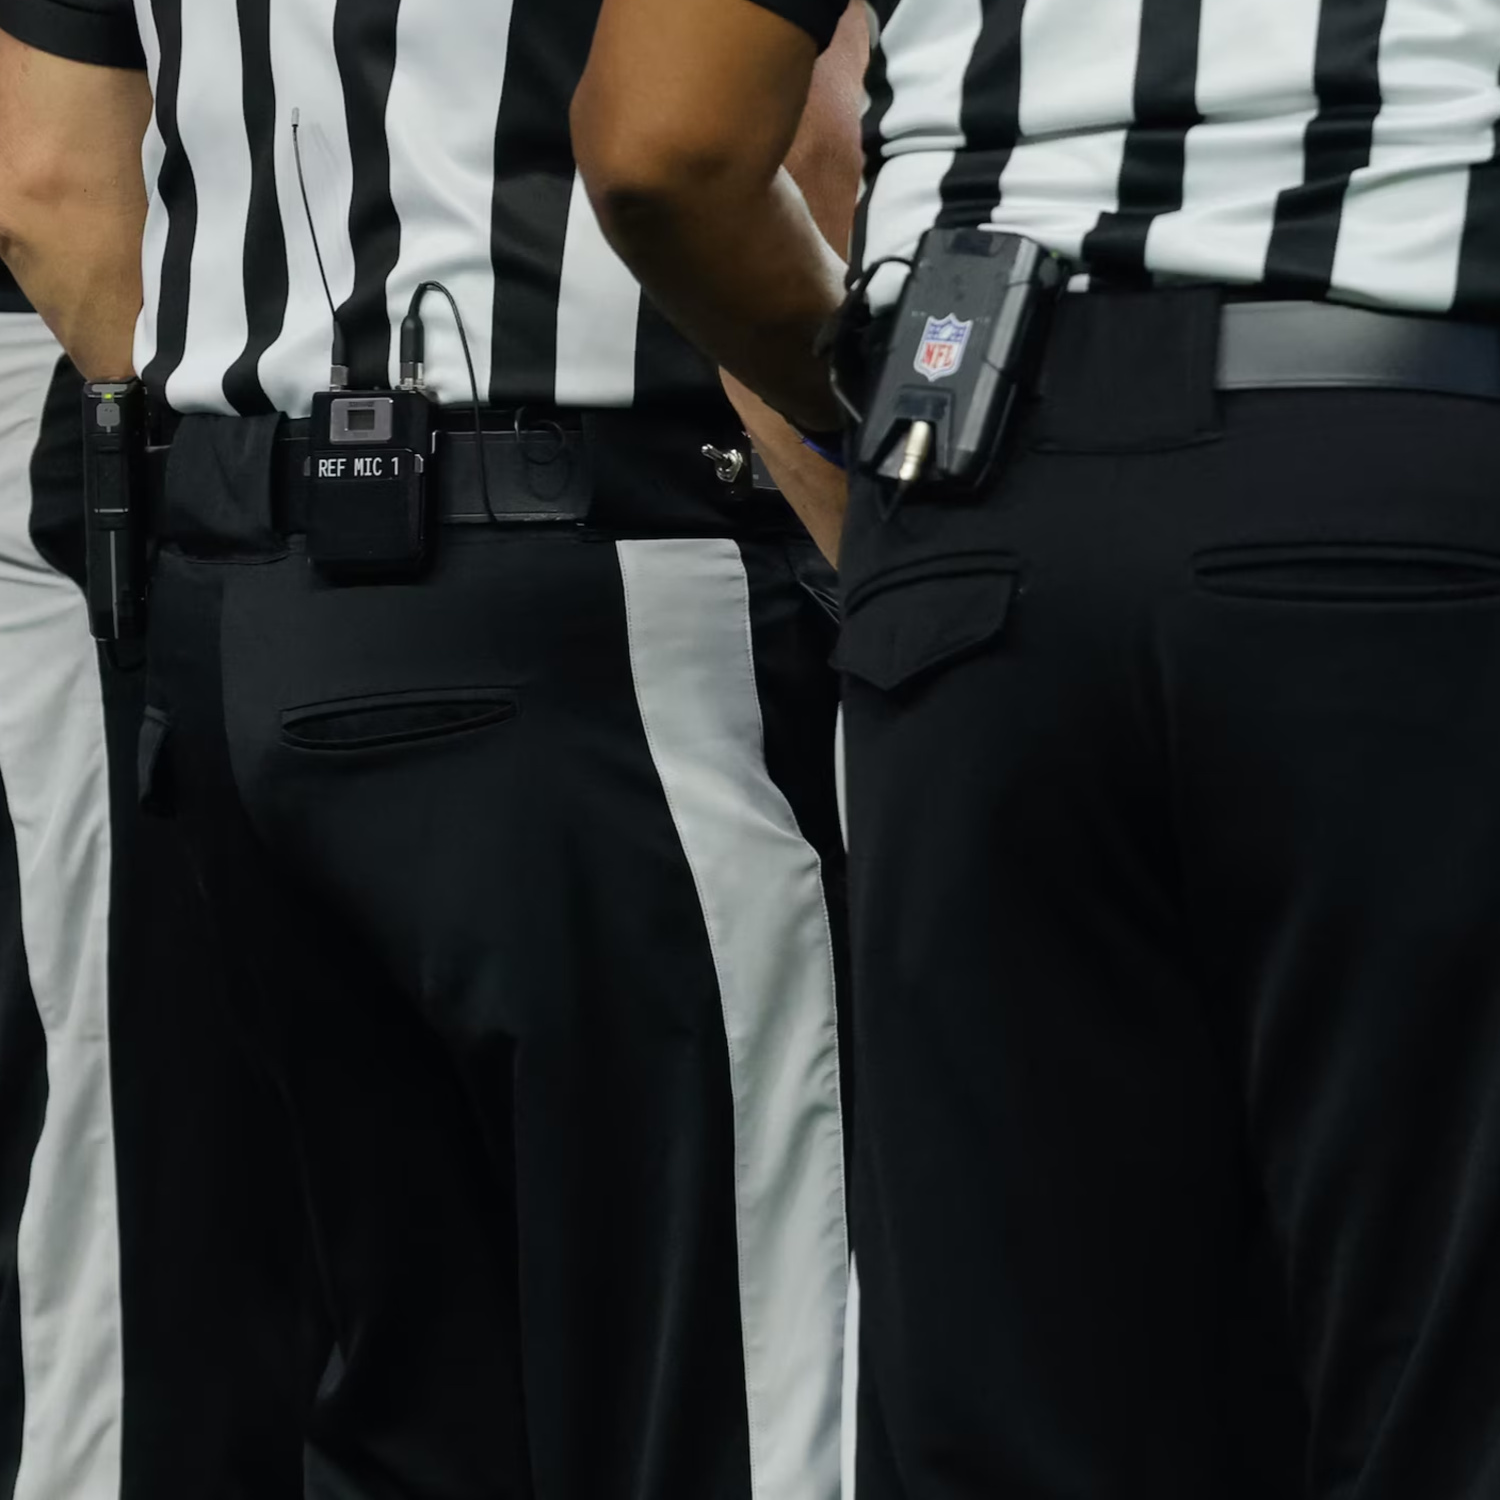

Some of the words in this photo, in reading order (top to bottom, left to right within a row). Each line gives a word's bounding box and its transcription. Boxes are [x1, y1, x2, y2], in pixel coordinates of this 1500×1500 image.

[922, 343, 955, 368] NFL
[318, 458, 347, 477] REF
[353, 456, 383, 476] MIC
[391, 456, 399, 476] 1
